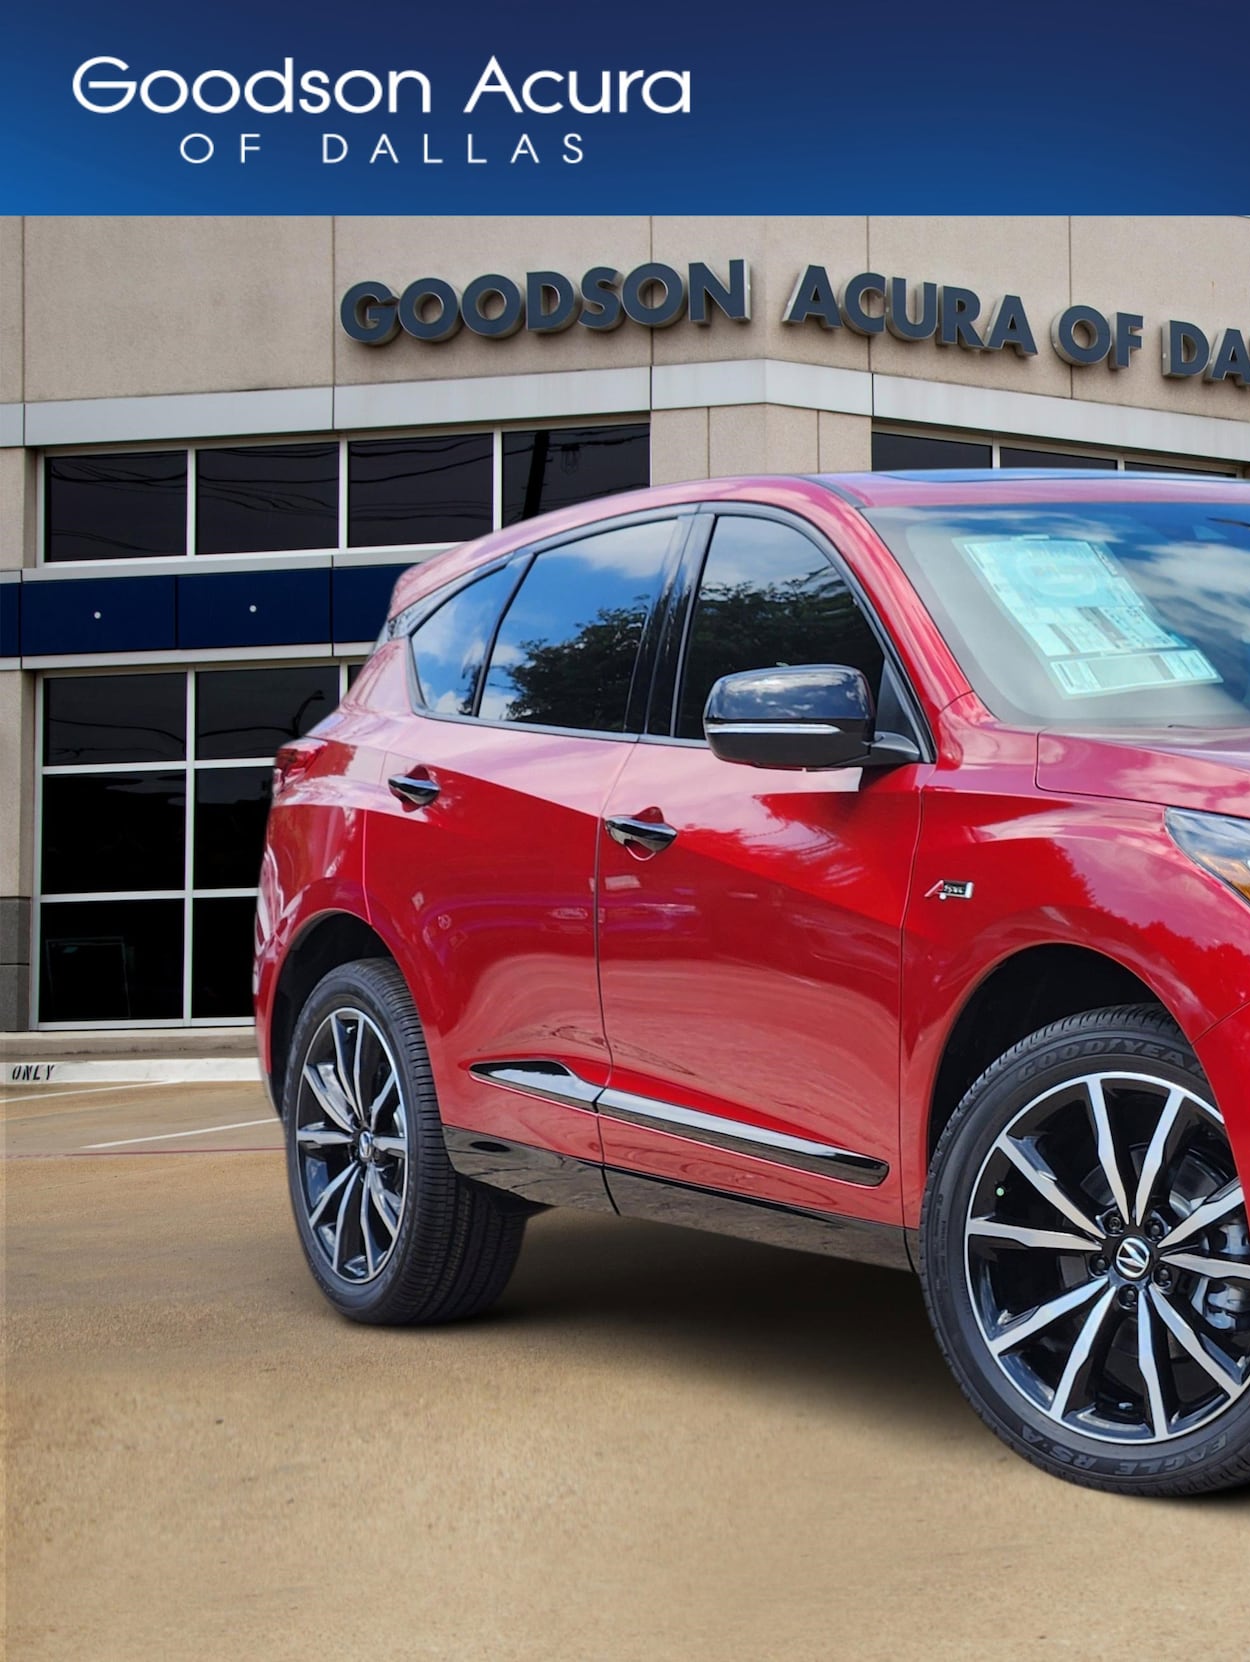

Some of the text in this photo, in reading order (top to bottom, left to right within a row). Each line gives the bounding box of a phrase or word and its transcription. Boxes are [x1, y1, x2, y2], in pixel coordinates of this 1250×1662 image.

[340, 259, 751, 347] GOODSON
[782, 264, 1039, 357] ACURA
[1051, 305, 1144, 370] OF
[12, 1064, 55, 1081] ONLY
[1114, 1431, 1228, 1476] EAGLE
